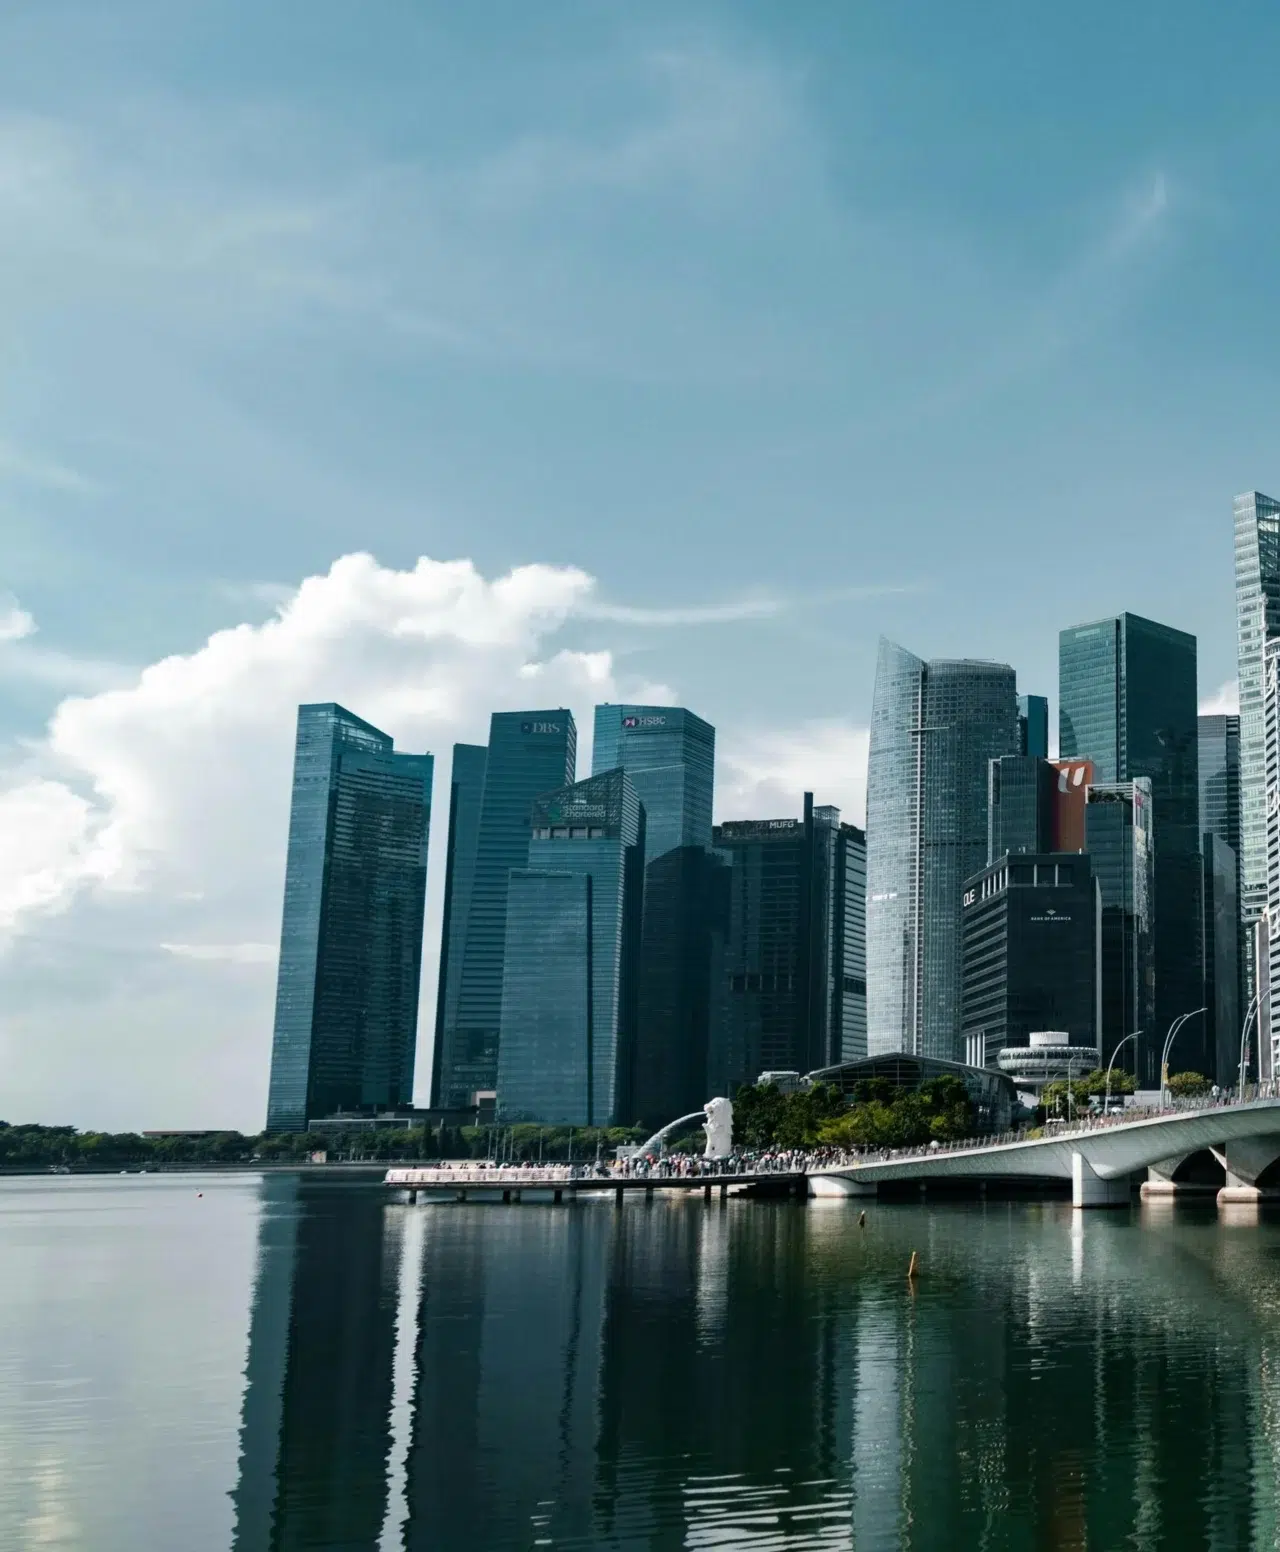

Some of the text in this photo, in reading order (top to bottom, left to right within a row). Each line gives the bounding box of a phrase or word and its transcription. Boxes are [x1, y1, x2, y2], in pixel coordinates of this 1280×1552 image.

[640, 716, 666, 726] HSBC
[533, 722, 560, 733] DBS
[769, 821, 795, 829] MUFG
